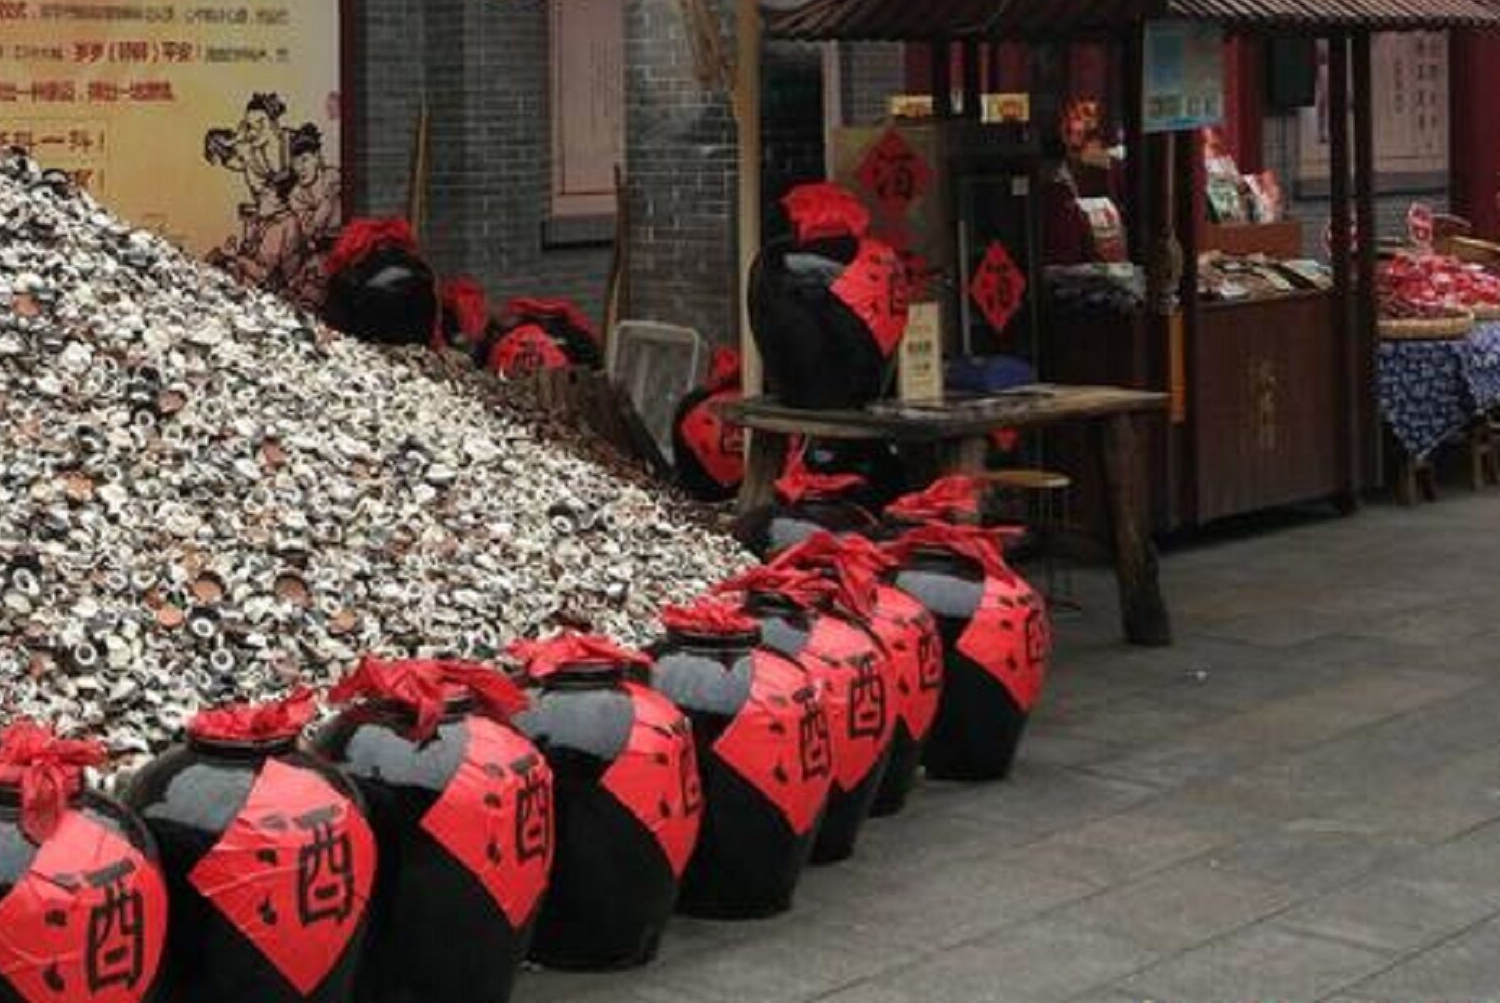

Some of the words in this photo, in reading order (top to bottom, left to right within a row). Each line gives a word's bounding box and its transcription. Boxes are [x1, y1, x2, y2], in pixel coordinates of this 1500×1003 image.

[767, 683, 833, 785] 酒
[254, 805, 355, 929] 酒
[481, 754, 550, 869] 酒
[41, 859, 145, 996] 酒
